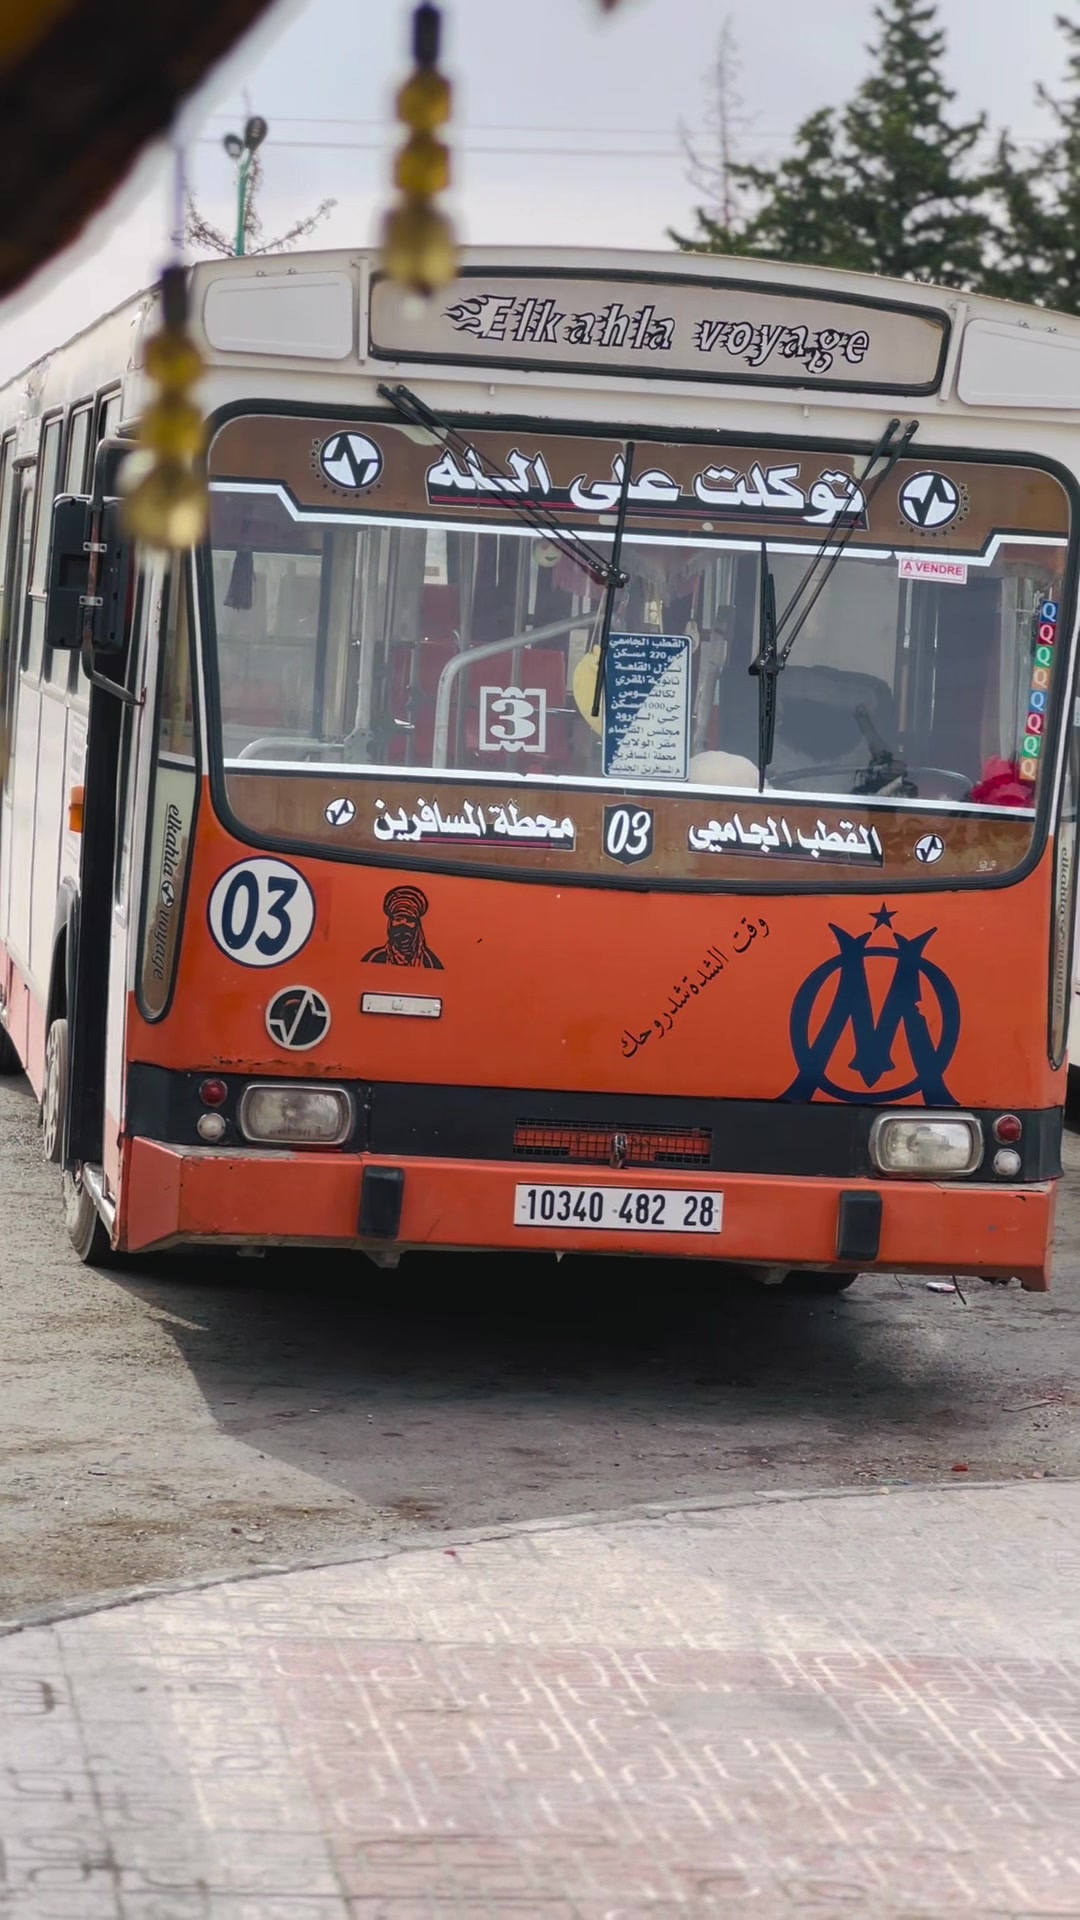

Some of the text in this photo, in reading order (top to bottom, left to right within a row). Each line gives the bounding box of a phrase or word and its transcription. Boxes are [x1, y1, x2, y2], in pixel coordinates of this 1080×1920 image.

[468, 294, 870, 374] Elkahla voyage
[427, 446, 866, 523] توكلت على الله
[915, 563, 963, 576] VENDRE
[1042, 602, 1056, 622] Q
[609, 637, 685, 648] القطب الجامعي
[1039, 625, 1053, 644] Q
[649, 651, 666, 659] 270
[1036, 647, 1050, 666] Q
[1033, 669, 1047, 688] Q
[1030, 691, 1044, 711] Q
[490, 699, 536, 740] 3
[1027, 713, 1041, 733] Q
[1024, 736, 1038, 756] Q
[1021, 759, 1035, 779] Q
[373, 796, 575, 841] محطة المسافرين
[606, 809, 652, 855] 03
[688, 812, 883, 858] القطب الجامعي
[151, 803, 182, 980] elkahla voyage
[221, 869, 299, 956] 03
[732, 917, 770, 954] وقت
[527, 1188, 714, 1227] 10340 482 28
